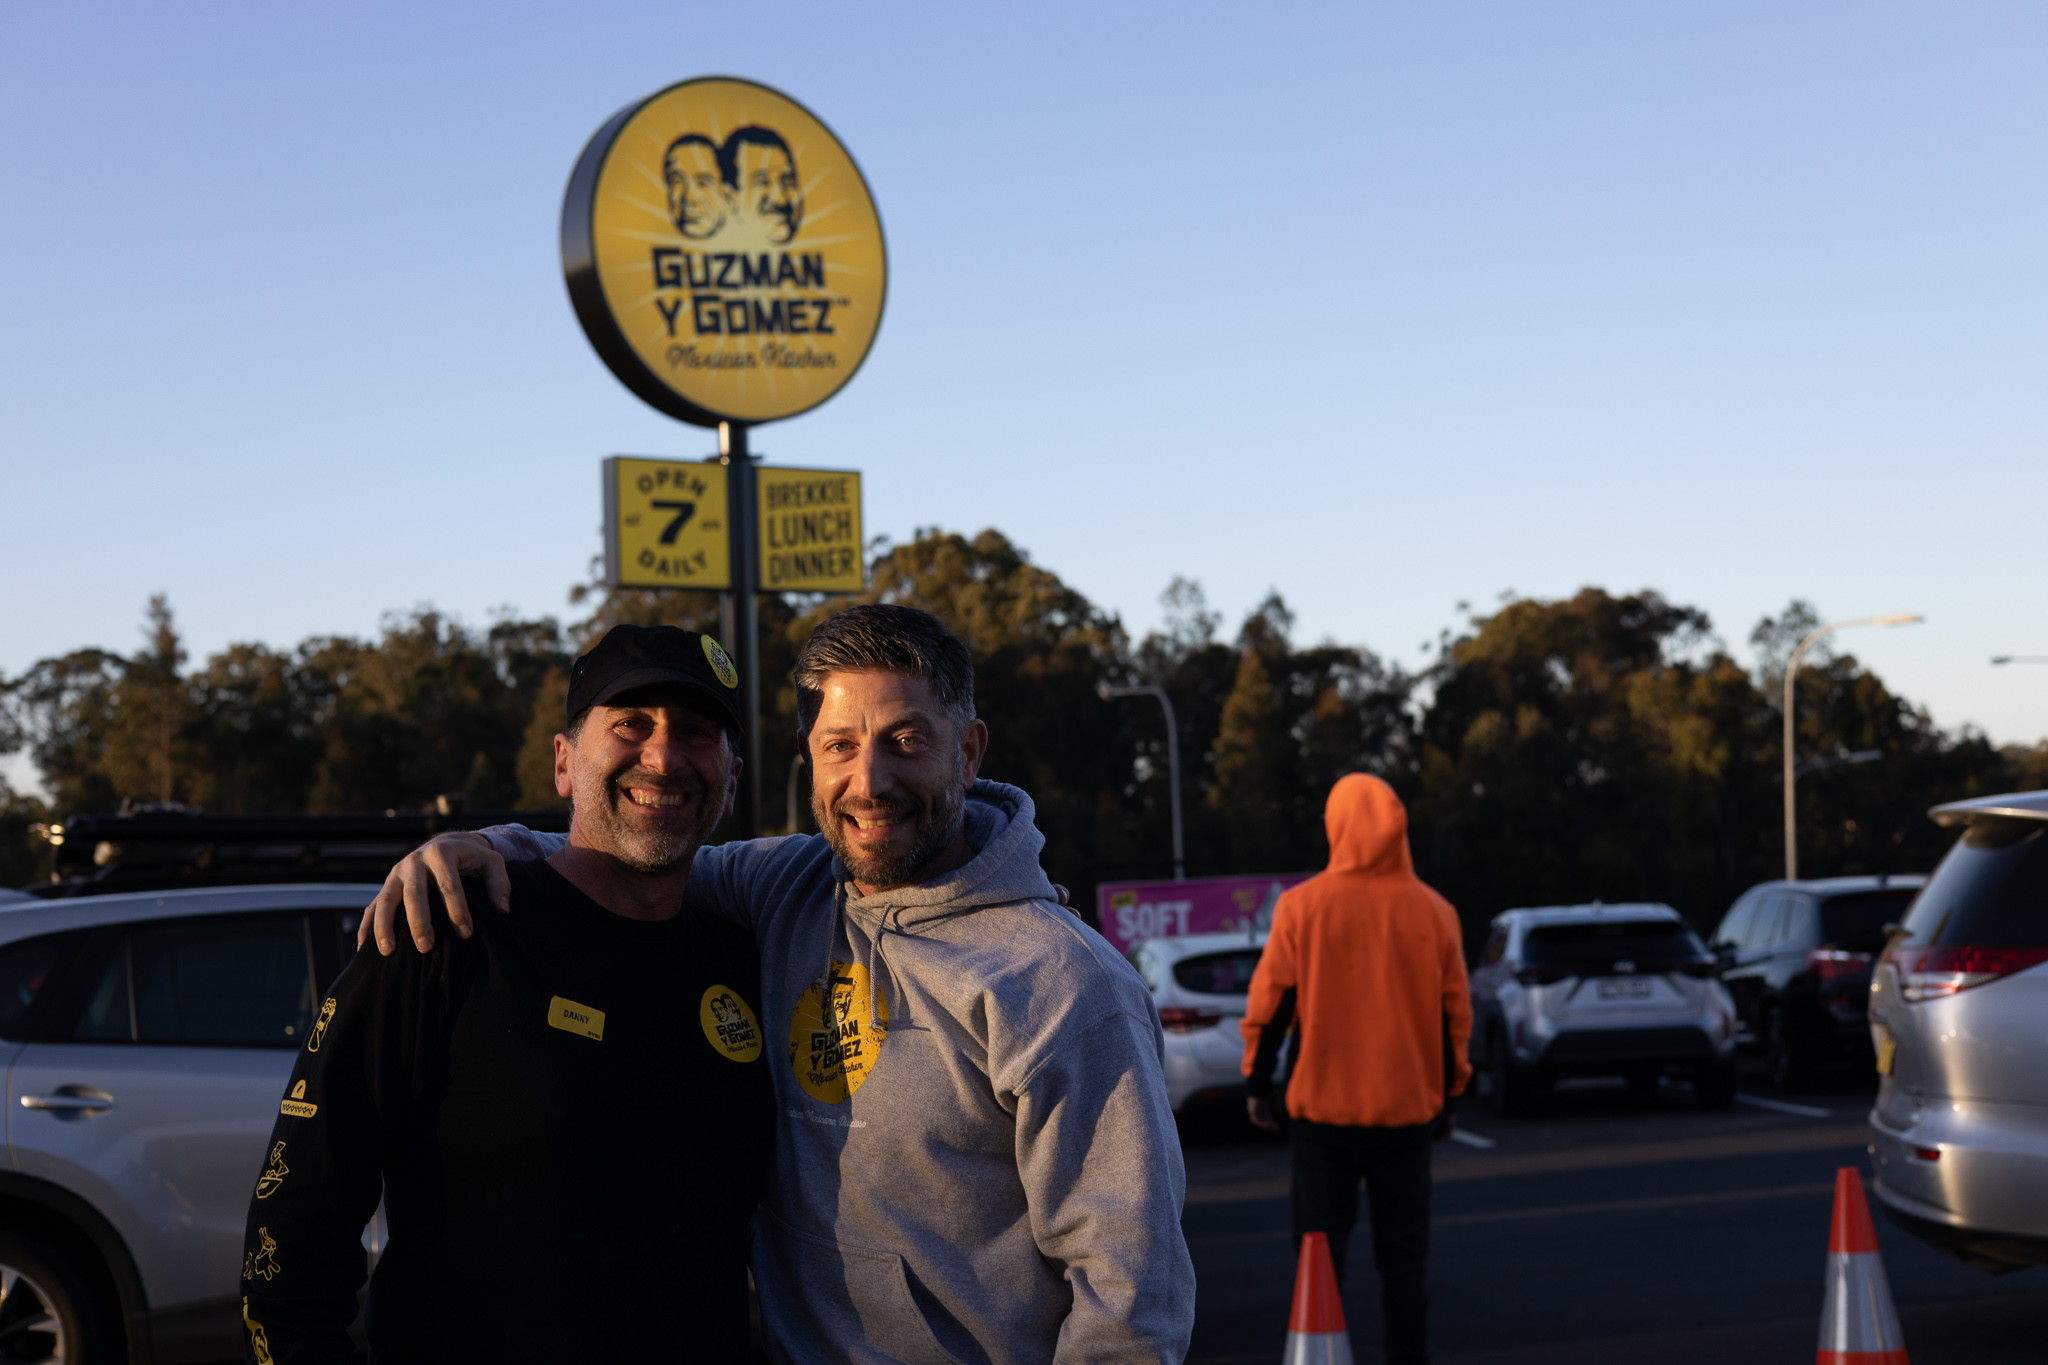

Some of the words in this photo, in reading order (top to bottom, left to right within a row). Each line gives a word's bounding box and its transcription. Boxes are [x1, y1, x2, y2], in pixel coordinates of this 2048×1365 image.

[652, 248, 826, 290] GUZMAN
[656, 297, 682, 336] Y
[692, 295, 835, 335] GOMEZ
[637, 468, 708, 497] OPEN
[766, 479, 848, 510] BREKKIE
[651, 500, 695, 545] 7
[768, 510, 852, 549] LUNCH
[637, 550, 707, 577] DAILY
[769, 548, 855, 583] DINNER
[1116, 901, 1191, 939] SOFT
[563, 1009, 590, 1024] DANNY
[716, 1019, 750, 1036] GUZMAN
[720, 1036, 728, 1046] Y
[728, 1030, 755, 1044] GOMEZ
[810, 1053, 821, 1071] Y
